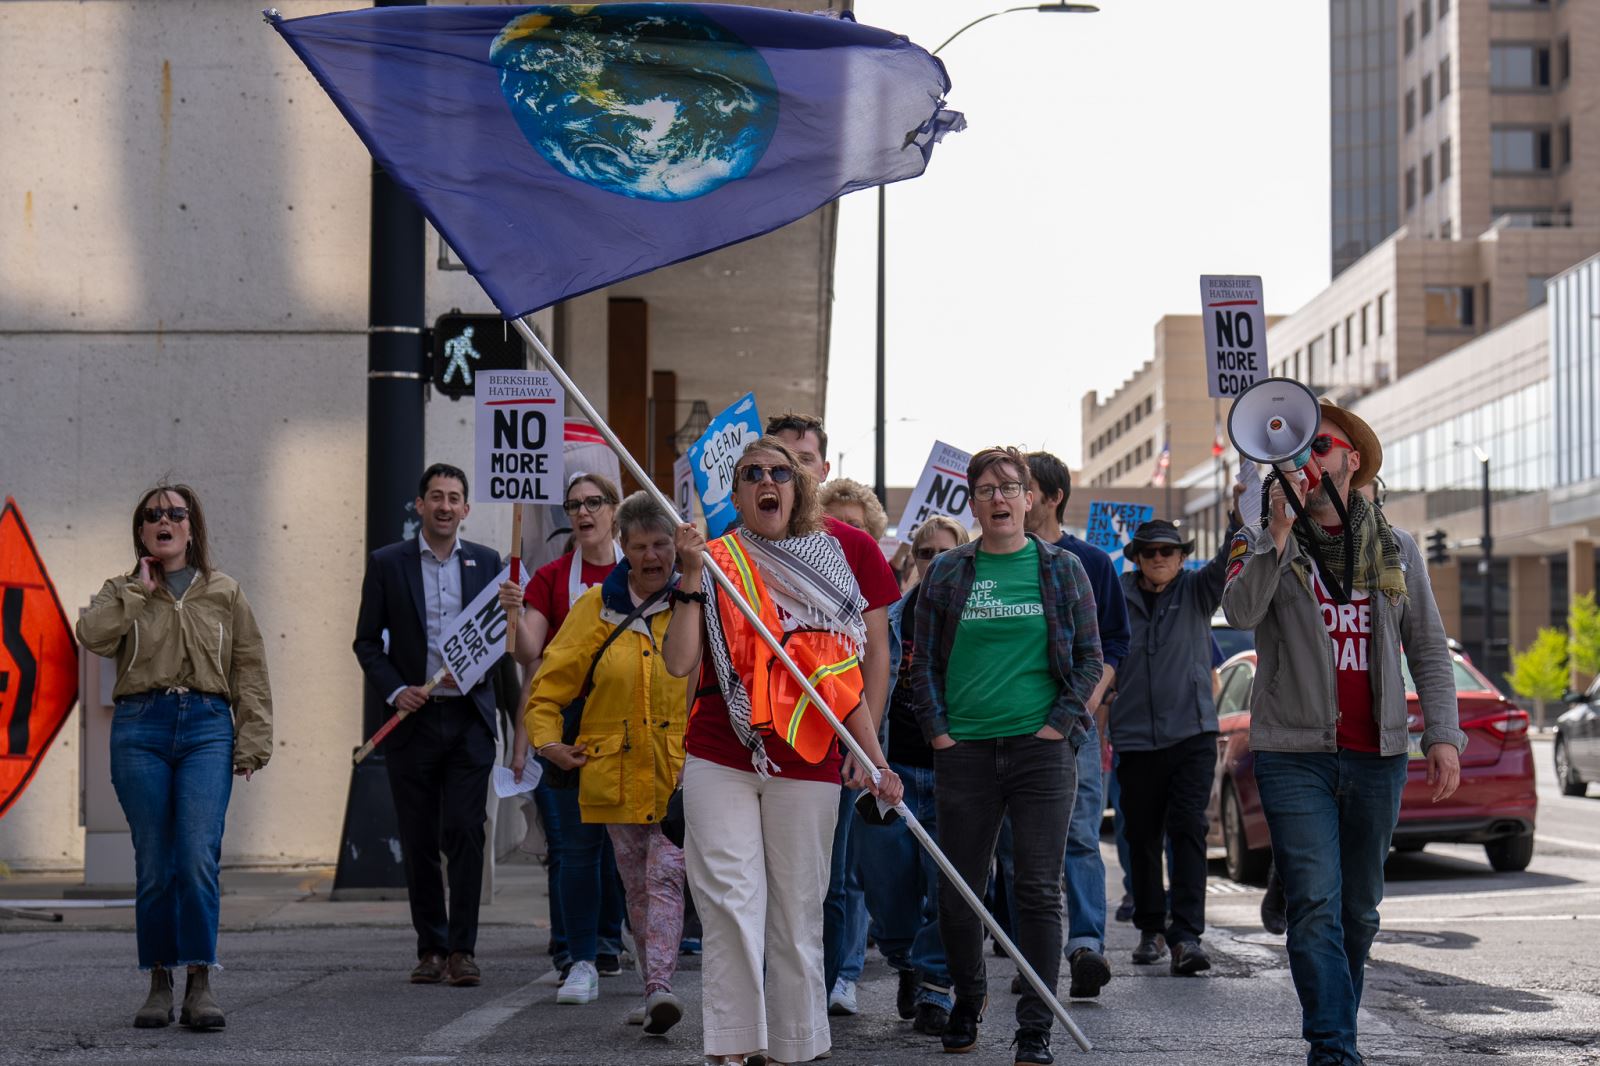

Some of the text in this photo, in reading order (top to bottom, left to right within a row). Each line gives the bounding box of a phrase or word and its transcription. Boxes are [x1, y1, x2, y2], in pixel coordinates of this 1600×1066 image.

[1209, 279, 1251, 288] BERKSHIRE
[1209, 289, 1254, 299] HATHAWAY
[1215, 310, 1253, 349] NO
[1217, 351, 1258, 371] MORE
[489, 375, 549, 386] BERKSHIRE
[488, 387, 552, 397] HATHAWAY
[493, 409, 547, 450] NO
[704, 428, 742, 470] CLEAN
[942, 447, 969, 463] BERKS
[491, 453, 548, 474] MORE
[718, 454, 737, 490] AIR
[937, 455, 966, 472] HATHA
[490, 477, 549, 500] COAL
[925, 473, 969, 515] NO
[1092, 502, 1146, 519] INVEST
[1090, 518, 1108, 530] IN
[967, 589, 994, 601] AFE.
[972, 579, 998, 591] IND:
[965, 599, 1003, 608] LEAN.
[475, 593, 508, 645] NO
[1320, 603, 1372, 633] ORE
[459, 619, 489, 665] MORE
[443, 635, 472, 682] COAL
[1332, 638, 1369, 671] AL
